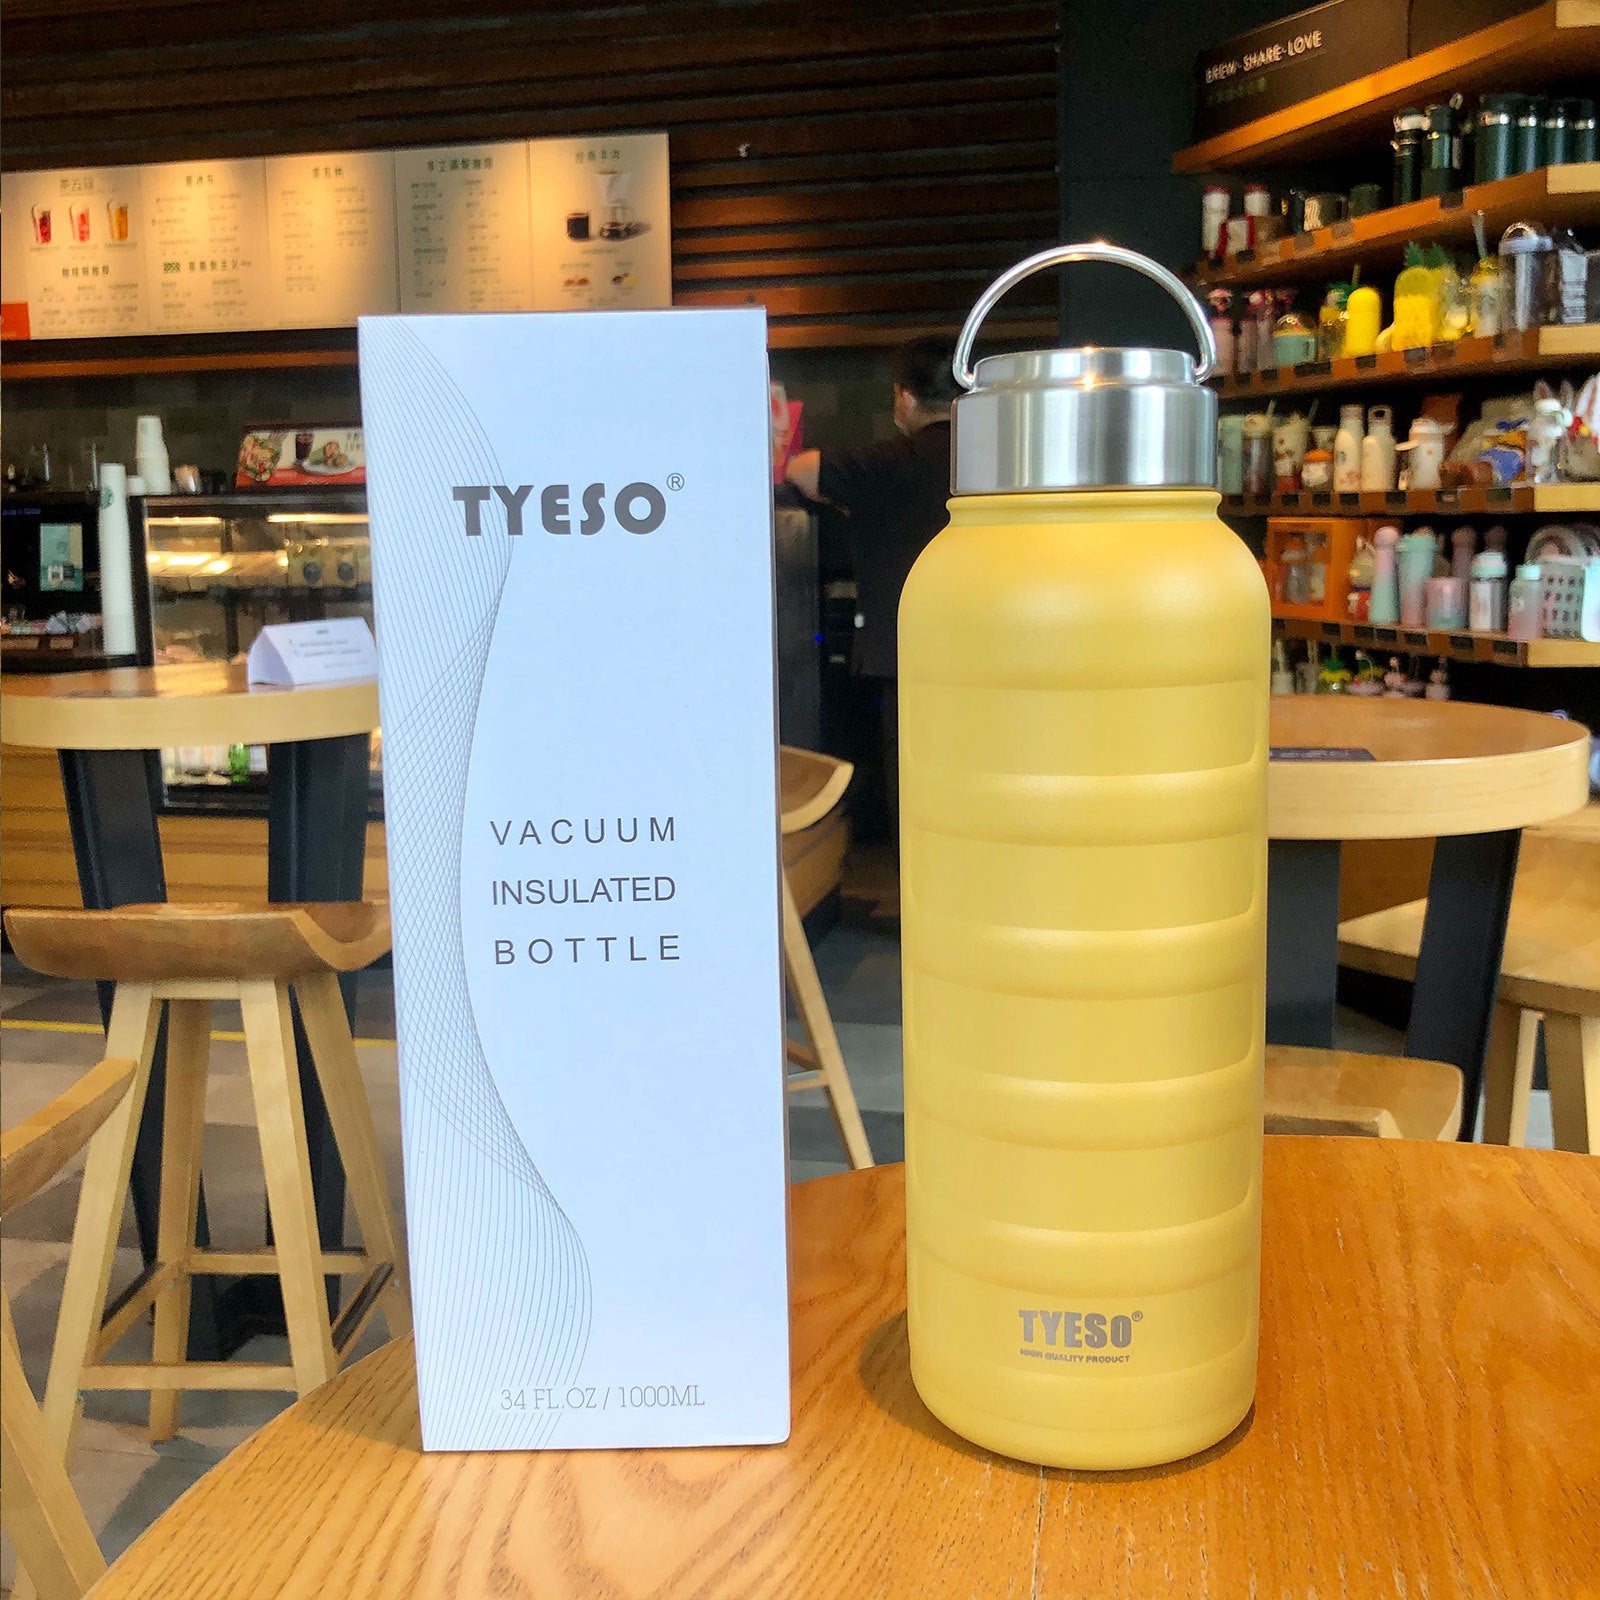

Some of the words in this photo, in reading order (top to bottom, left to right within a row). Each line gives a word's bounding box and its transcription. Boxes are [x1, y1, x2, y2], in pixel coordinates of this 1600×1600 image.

[1287, 30, 1322, 56] LOVE
[490, 817, 675, 845] VACUUM
[492, 876, 676, 905] INSULATED
[495, 935, 680, 965] BOTTLE
[1020, 1348, 1043, 1358] HIGH
[1045, 1352, 1084, 1363] QUALITY
[1086, 1355, 1130, 1364] PRODUCT
[501, 1389, 527, 1410] 34
[619, 1385, 706, 1408] 1000ML
